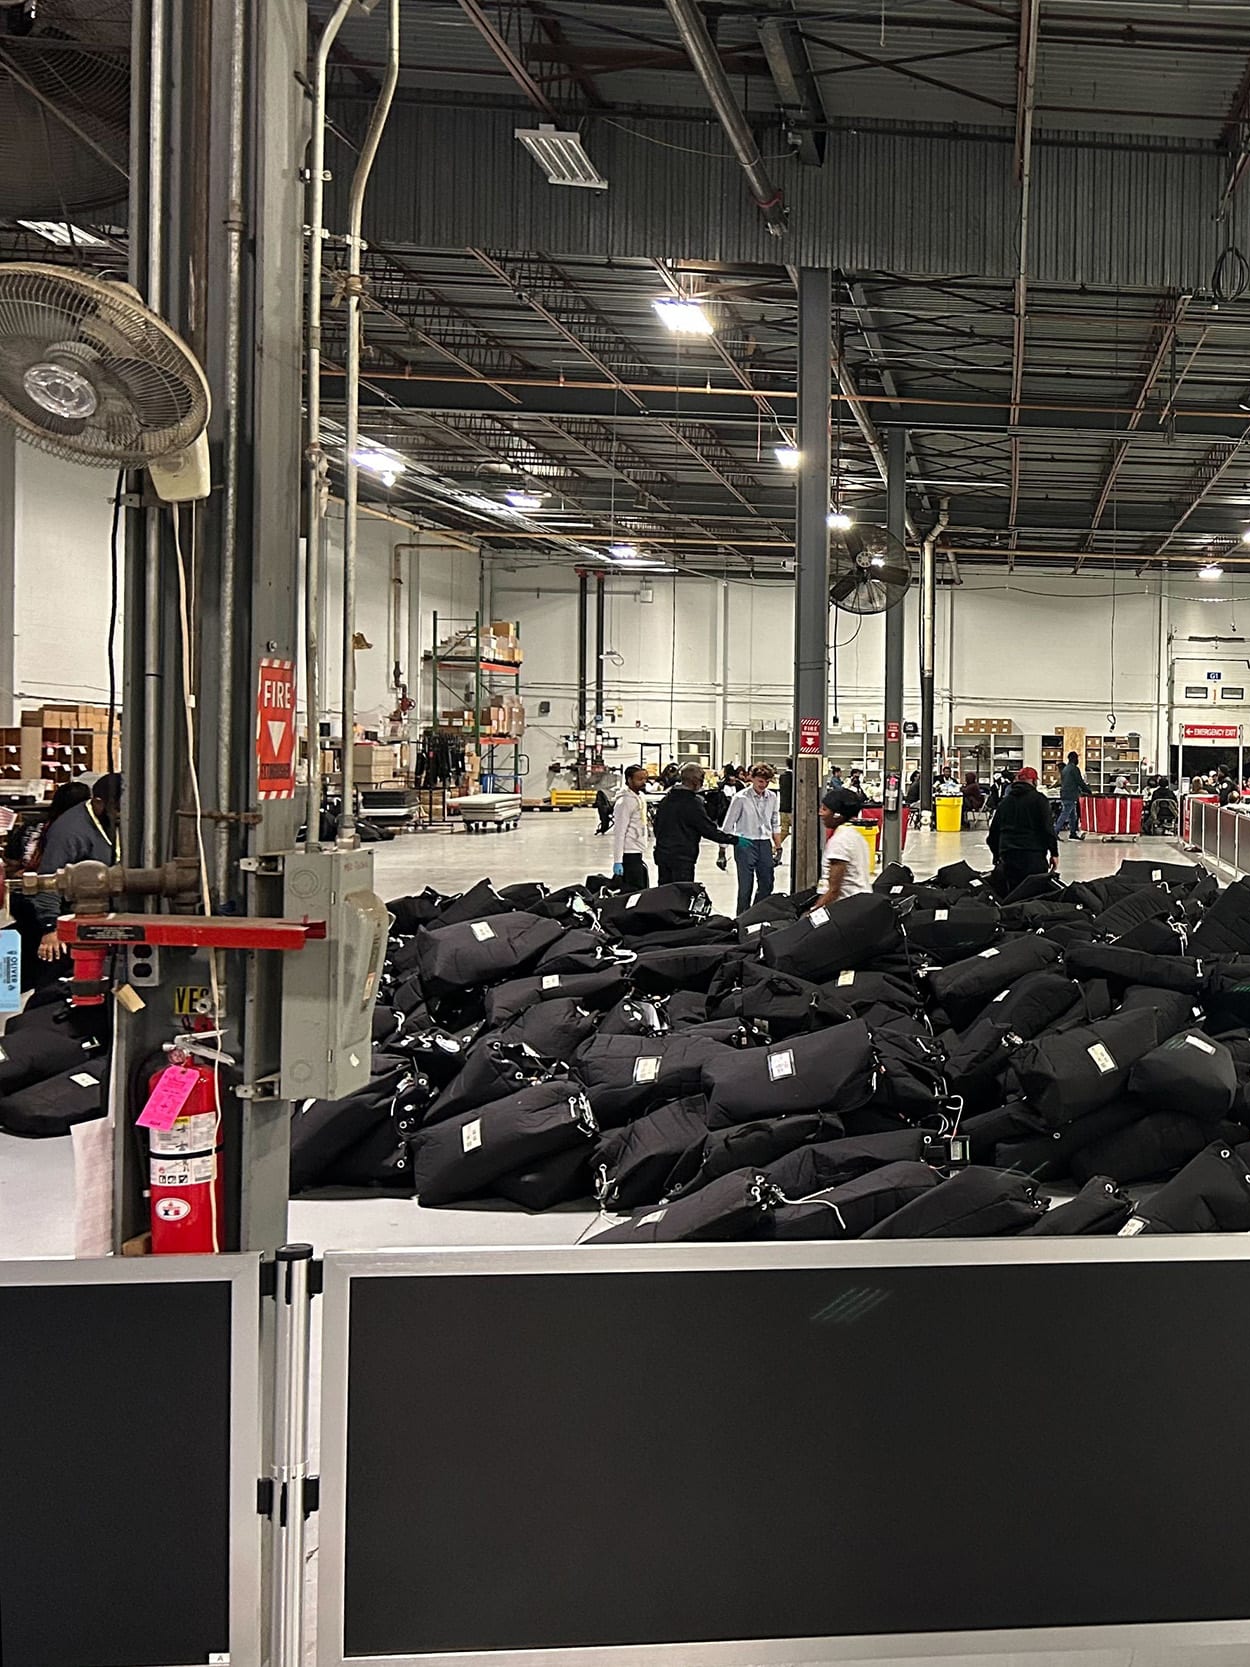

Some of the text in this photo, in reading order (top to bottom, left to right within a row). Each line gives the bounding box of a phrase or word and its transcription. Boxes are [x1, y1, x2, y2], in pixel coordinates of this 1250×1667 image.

[263, 680, 291, 708] FIRE
[1193, 728, 1224, 736] EMERGENCY
[10, 956, 18, 983] OLIVER
